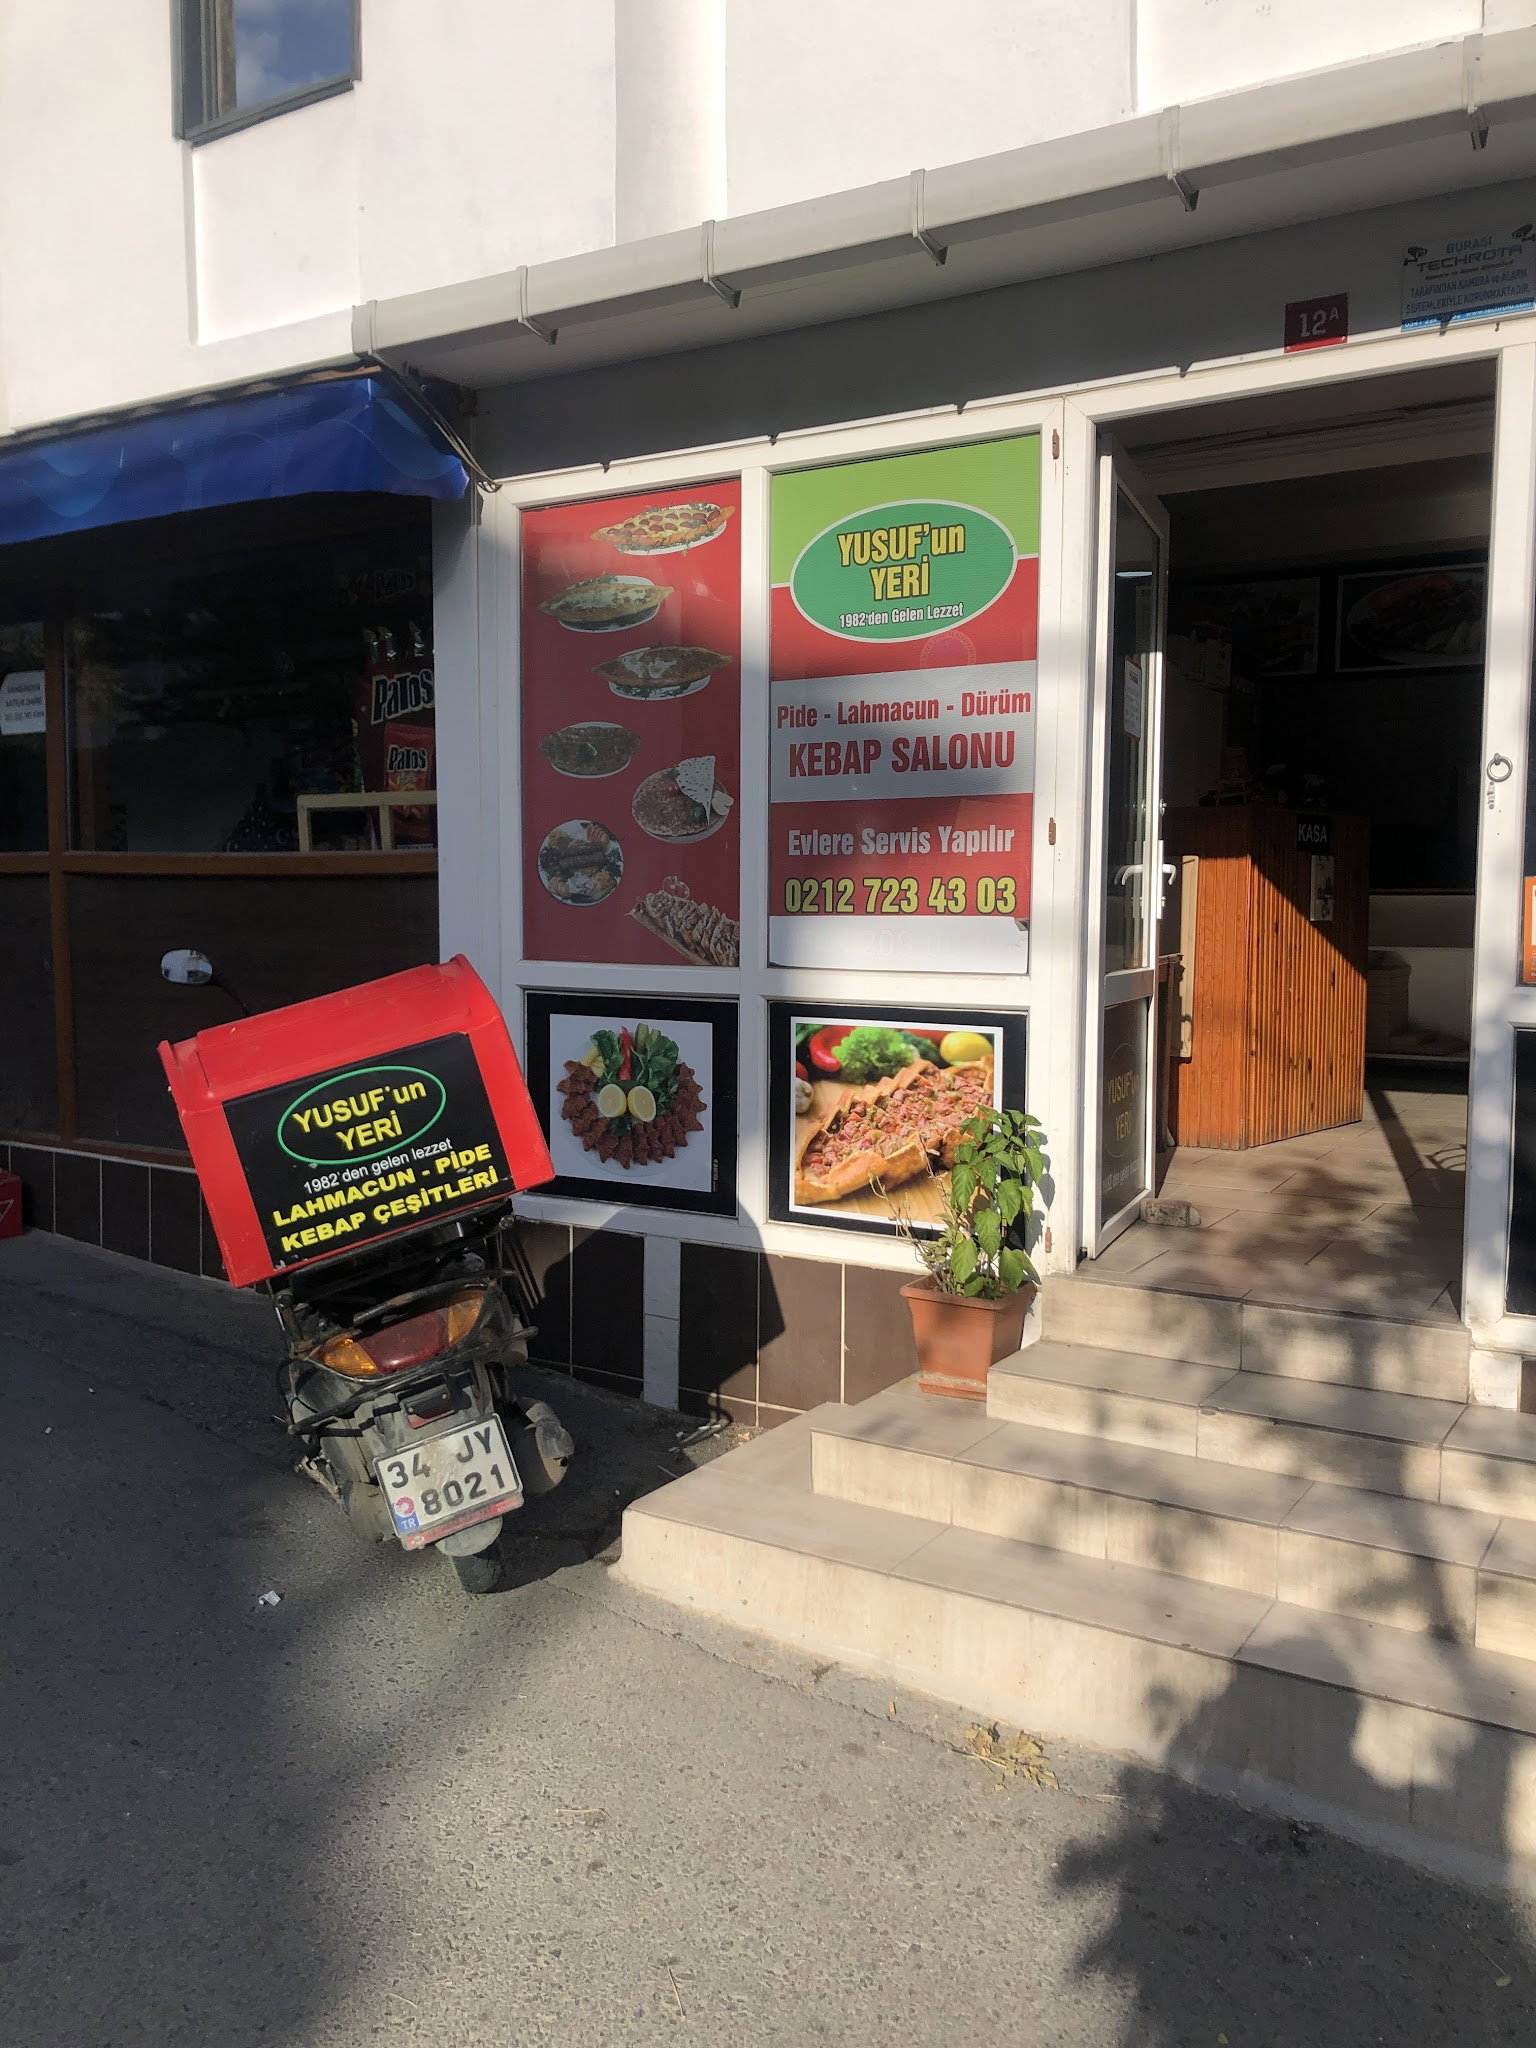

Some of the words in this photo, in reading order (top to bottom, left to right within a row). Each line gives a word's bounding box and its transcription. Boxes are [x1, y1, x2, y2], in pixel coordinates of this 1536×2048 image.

[870, 556, 930, 602] YERİ
[839, 611, 889, 629] 1982'den
[891, 606, 924, 623] Gelen
[926, 602, 964, 620] Lezzet
[777, 704, 818, 729] Pide
[837, 698, 939, 726] Lahmacun
[961, 689, 1031, 717] Dürüm
[789, 739, 882, 778] KEBAP
[891, 730, 1016, 774] SALONU
[788, 828, 854, 857] Evlere
[861, 826, 931, 855] Servis
[938, 824, 1015, 857] Yapılır
[1297, 823, 1328, 843] KASA
[784, 877, 855, 914] 0212
[863, 876, 919, 914] 723
[928, 876, 967, 914] 43
[975, 876, 1017, 914] 03
[335, 1109, 403, 1153] YERİ
[272, 1167, 416, 1228] LAHMACUN
[434, 1143, 493, 1176] PİDE
[303, 1162, 369, 1195] 1982'den
[371, 1151, 410, 1178] gelen
[411, 1137, 453, 1162] lezzet
[280, 1212, 367, 1253] KEBAP
[373, 1164, 499, 1226] ÇEŞİTLERİ
[387, 1452, 431, 1489] 34
[456, 1426, 492, 1464] JY
[420, 1463, 506, 1516] 8021
[401, 1517, 417, 1530] TR
